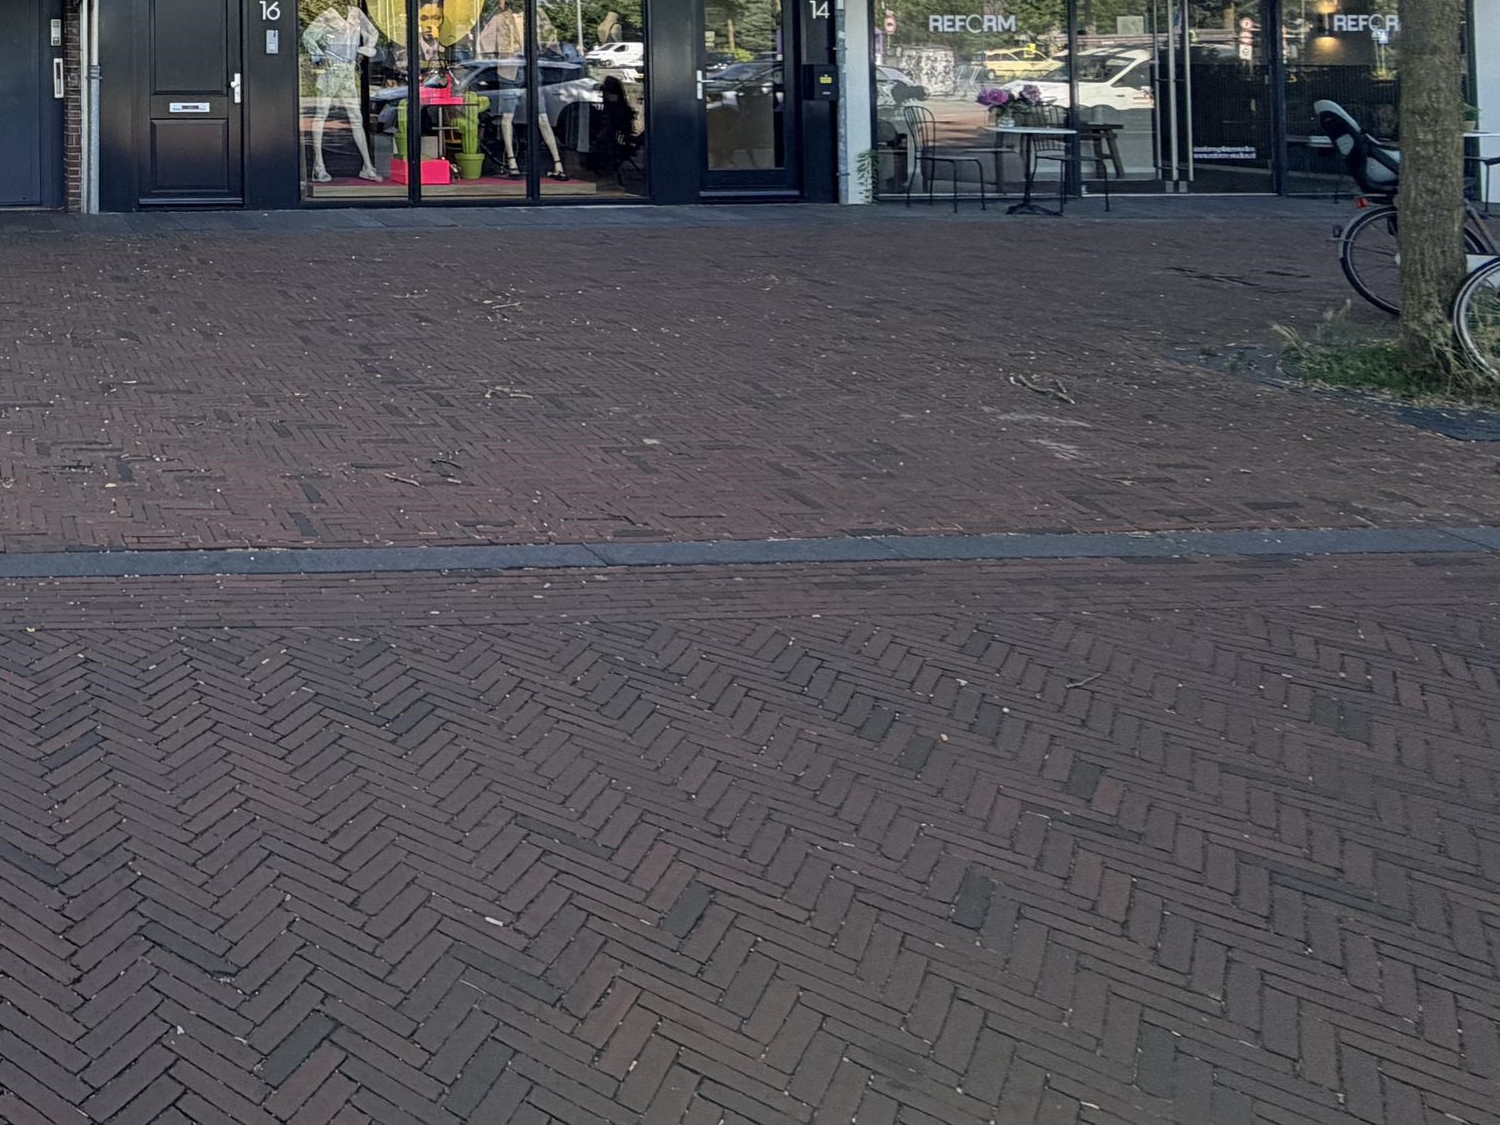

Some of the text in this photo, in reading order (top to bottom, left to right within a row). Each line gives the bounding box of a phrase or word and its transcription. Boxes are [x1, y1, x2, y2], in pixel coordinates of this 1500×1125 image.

[259, 0, 281, 21] 16
[808, 0, 831, 20] 14
[928, 13, 1017, 33] REFORM
[1333, 13, 1401, 32] REFOR
